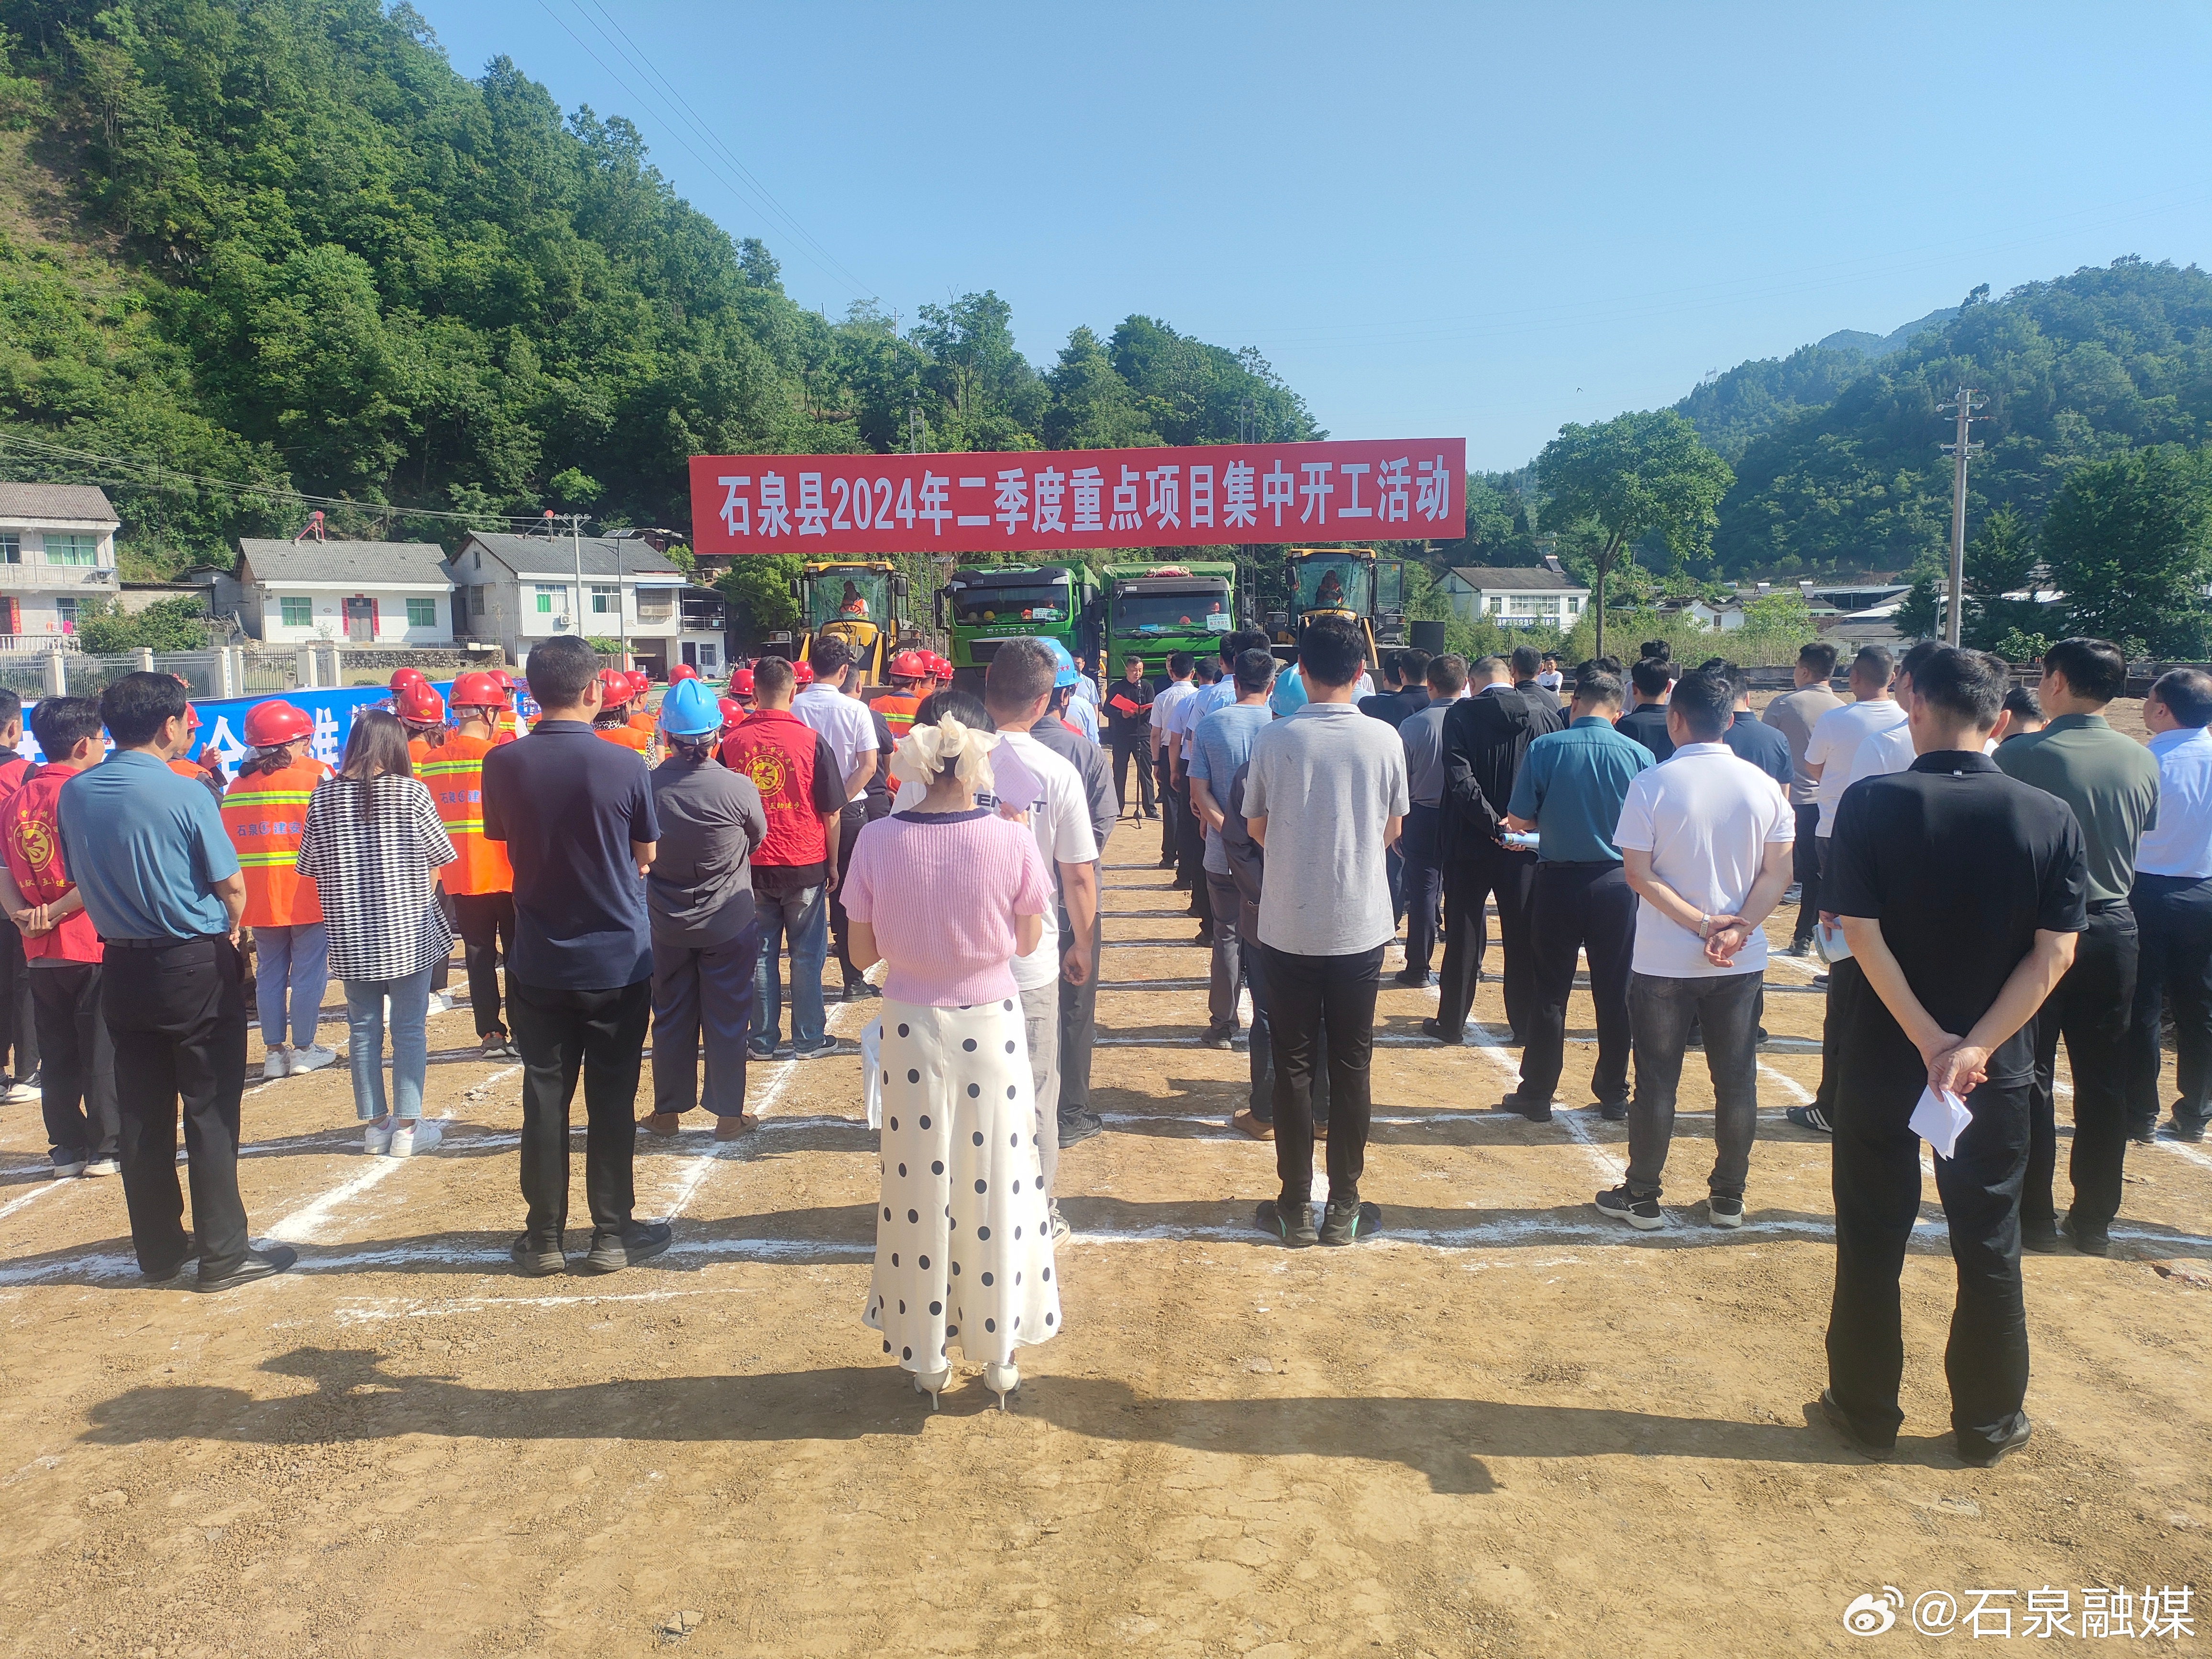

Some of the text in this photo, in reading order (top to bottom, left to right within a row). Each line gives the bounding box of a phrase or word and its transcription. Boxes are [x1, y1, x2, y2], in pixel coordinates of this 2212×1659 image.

[718, 455, 1449, 538] 石泉县2024年二季度重点项目集中开工活动
[273, 821, 301, 834] 建安
